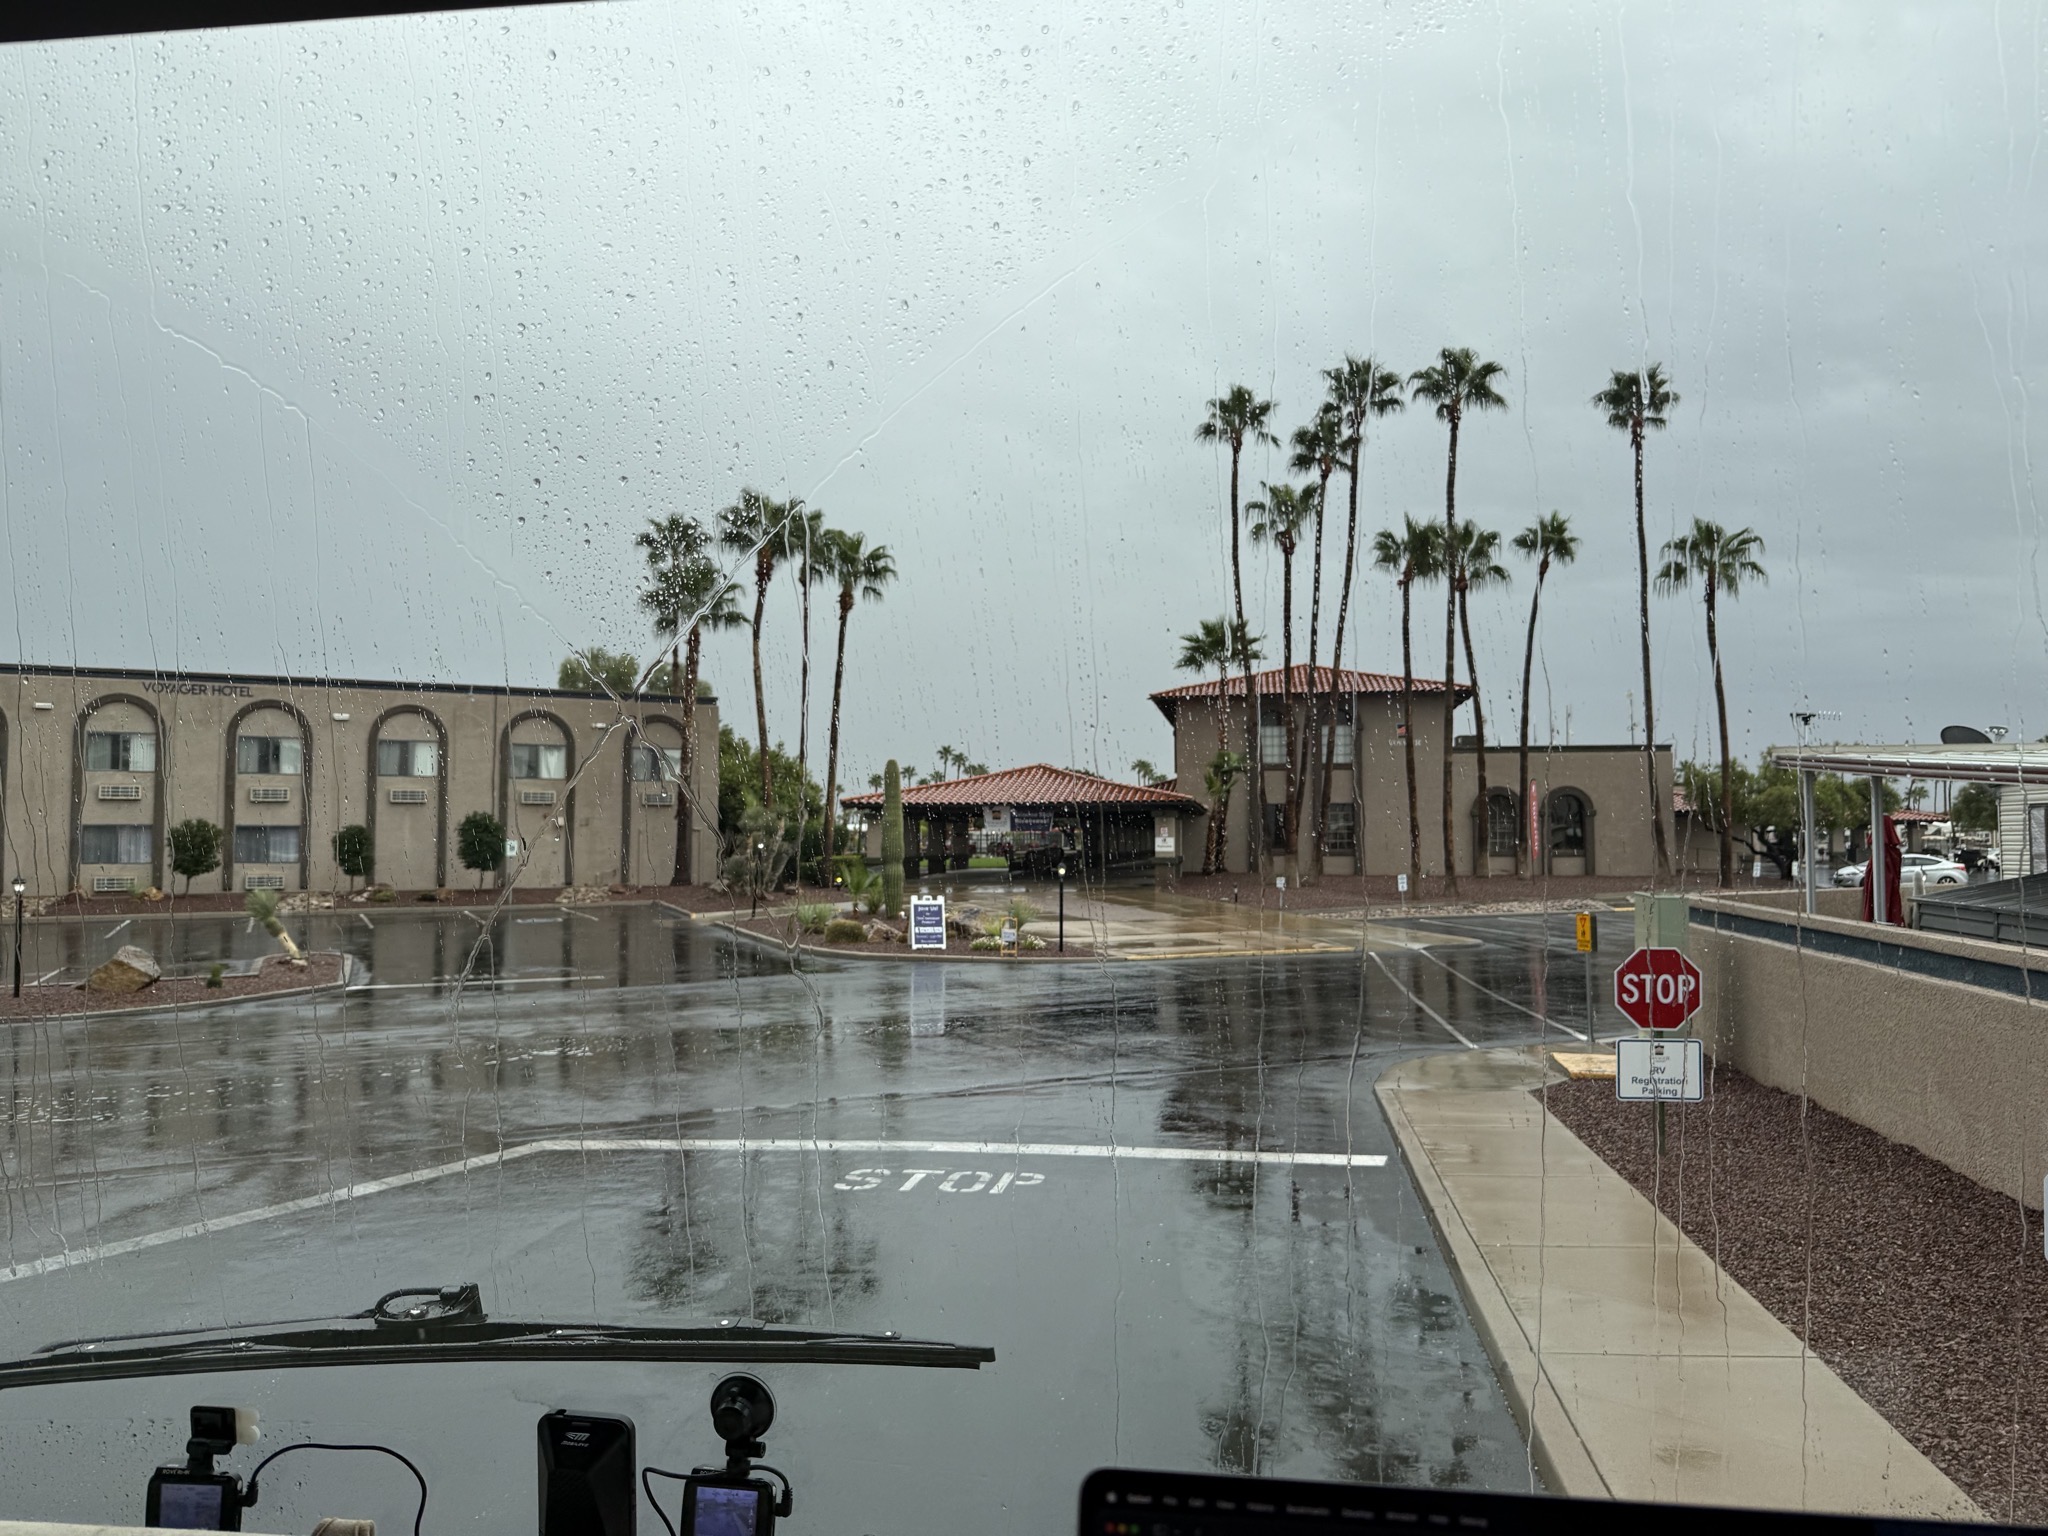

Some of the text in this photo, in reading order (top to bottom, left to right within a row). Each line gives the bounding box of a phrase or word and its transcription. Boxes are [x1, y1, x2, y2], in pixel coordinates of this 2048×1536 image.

[142, 682, 254, 698] VOYAGER HOTEL
[1621, 973, 1696, 1005] STOP
[1652, 1066, 1666, 1075] RV
[833, 1168, 1046, 1195] STOP
